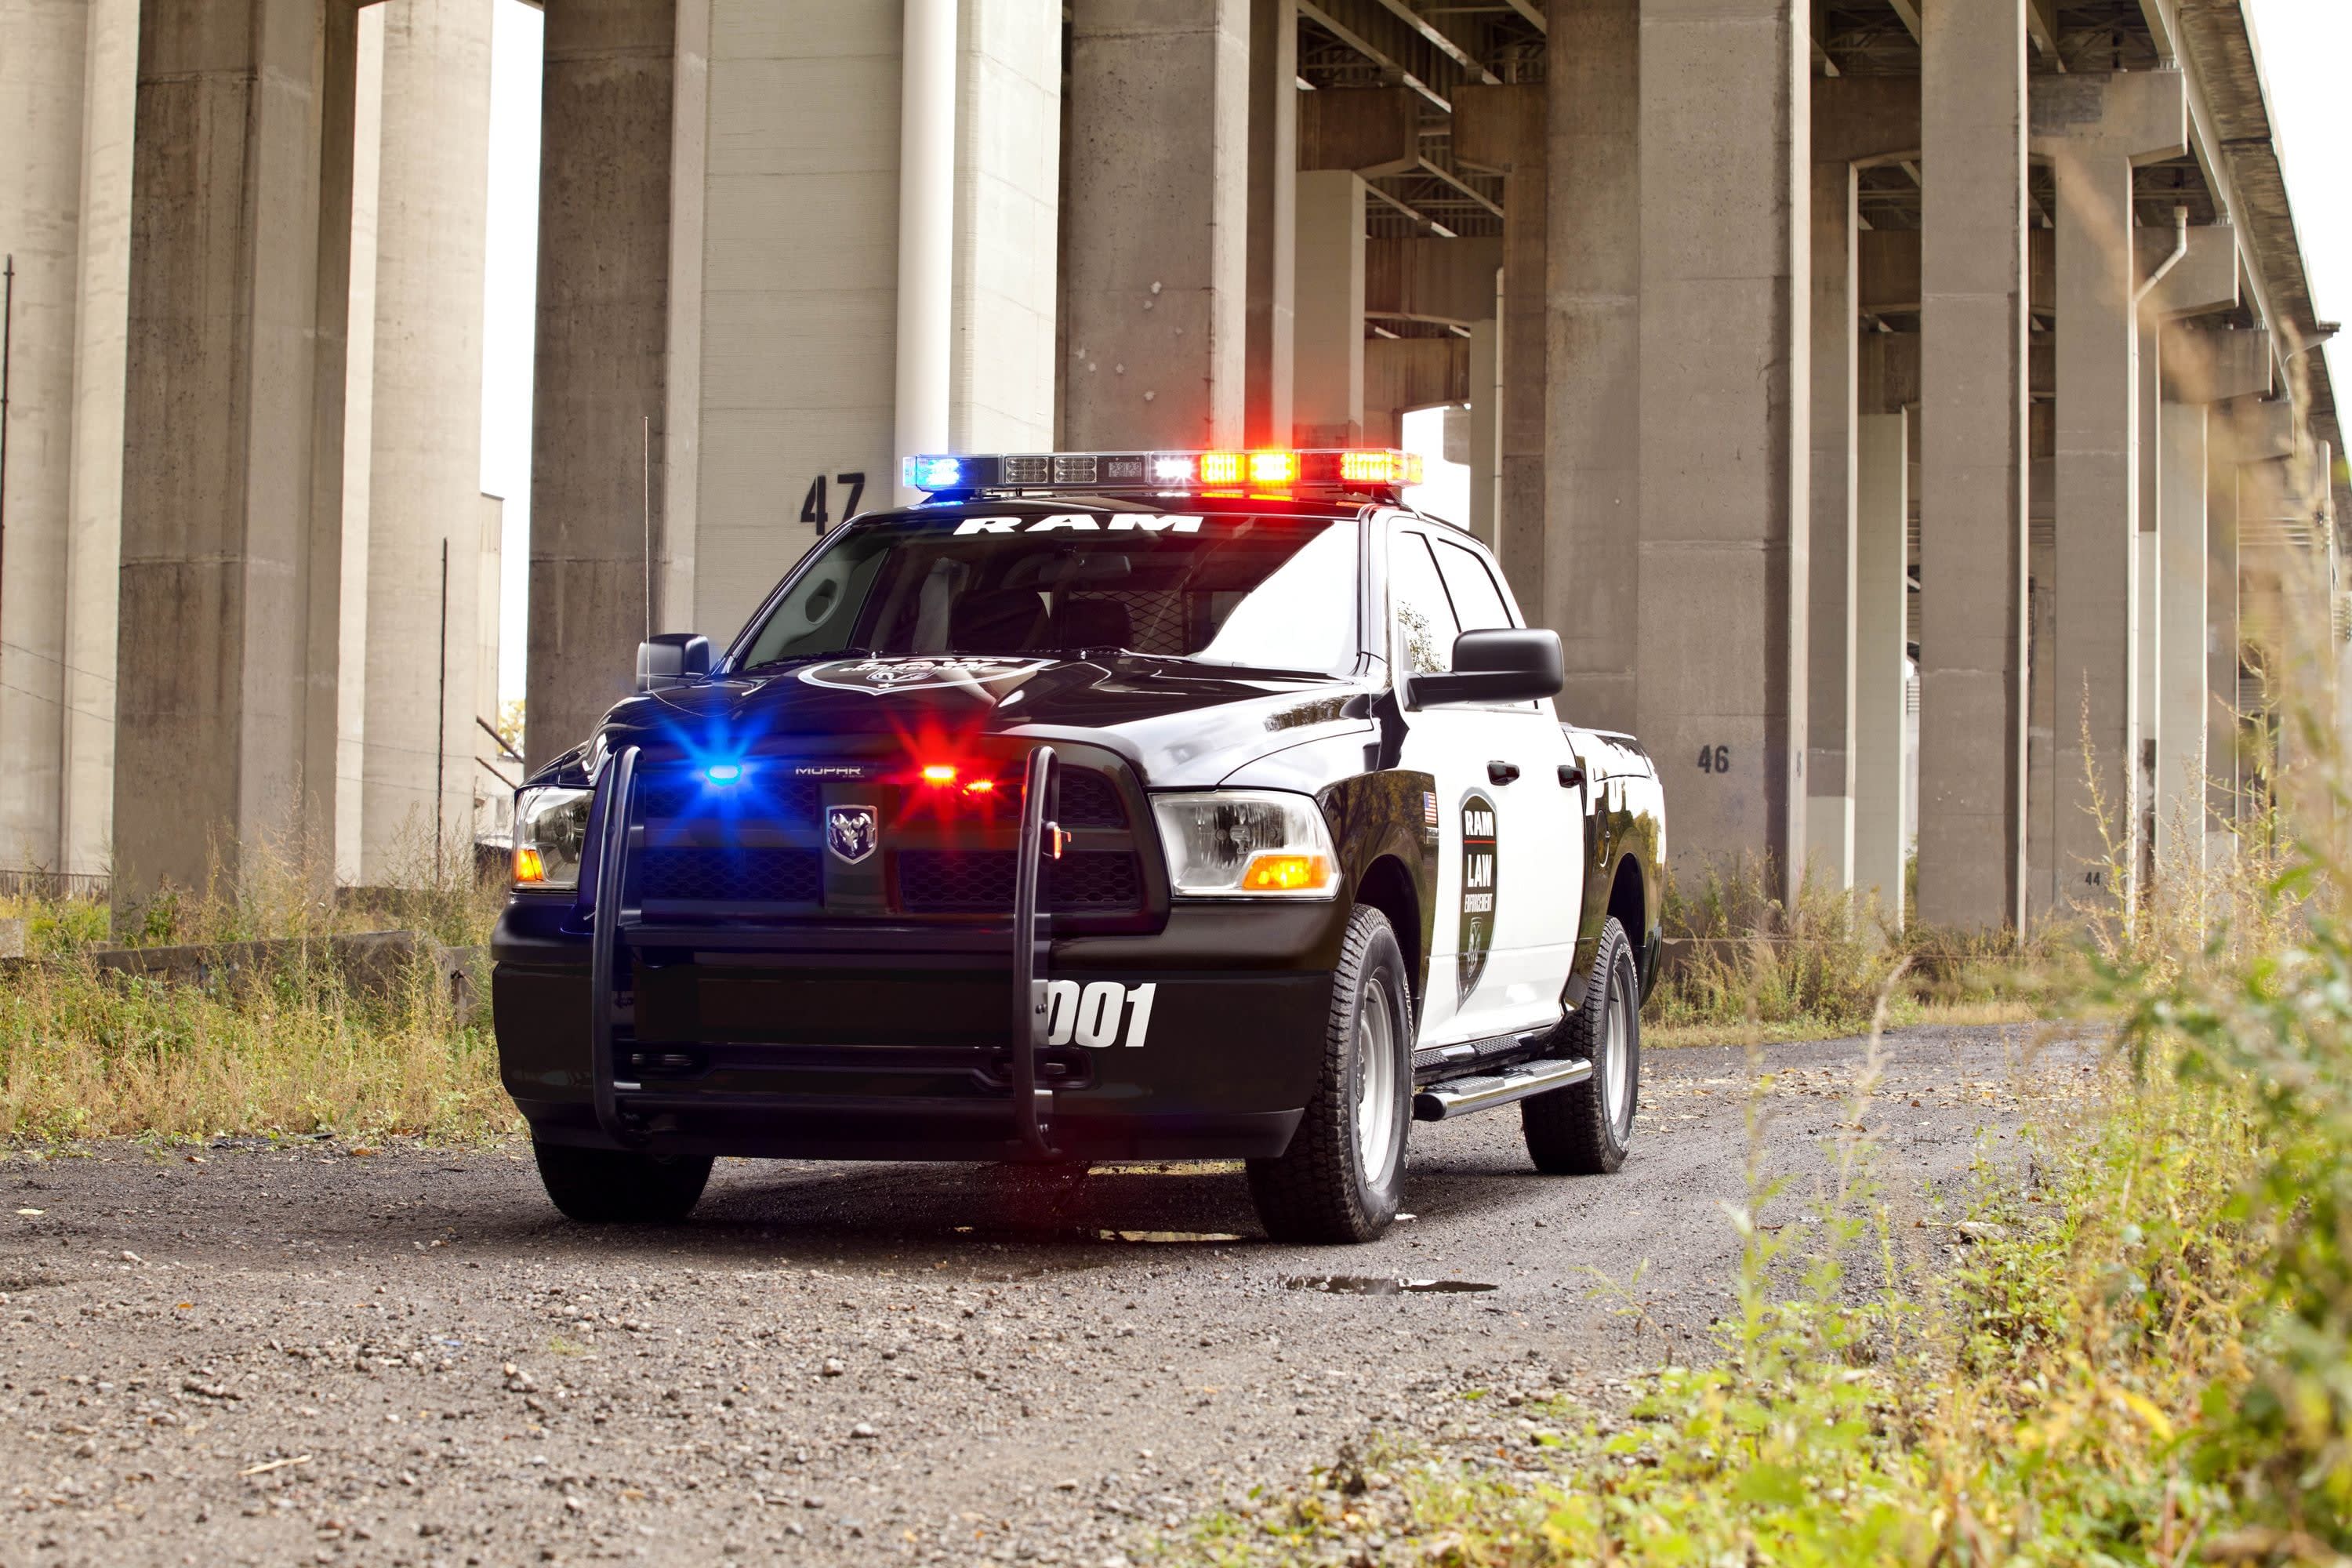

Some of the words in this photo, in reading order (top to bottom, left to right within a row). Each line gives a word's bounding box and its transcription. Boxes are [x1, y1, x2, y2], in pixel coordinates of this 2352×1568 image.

[800, 472, 865, 535] 47
[953, 514, 1204, 535] RAM
[795, 765, 862, 775] MOPAR
[1697, 745, 1730, 774] 46
[1465, 810, 1494, 836] RAM
[1467, 854, 1493, 887] LAW
[2085, 871, 2100, 886] 44
[1464, 893, 1494, 913] ENFORCEMENT
[1047, 980, 1156, 1047] 001
